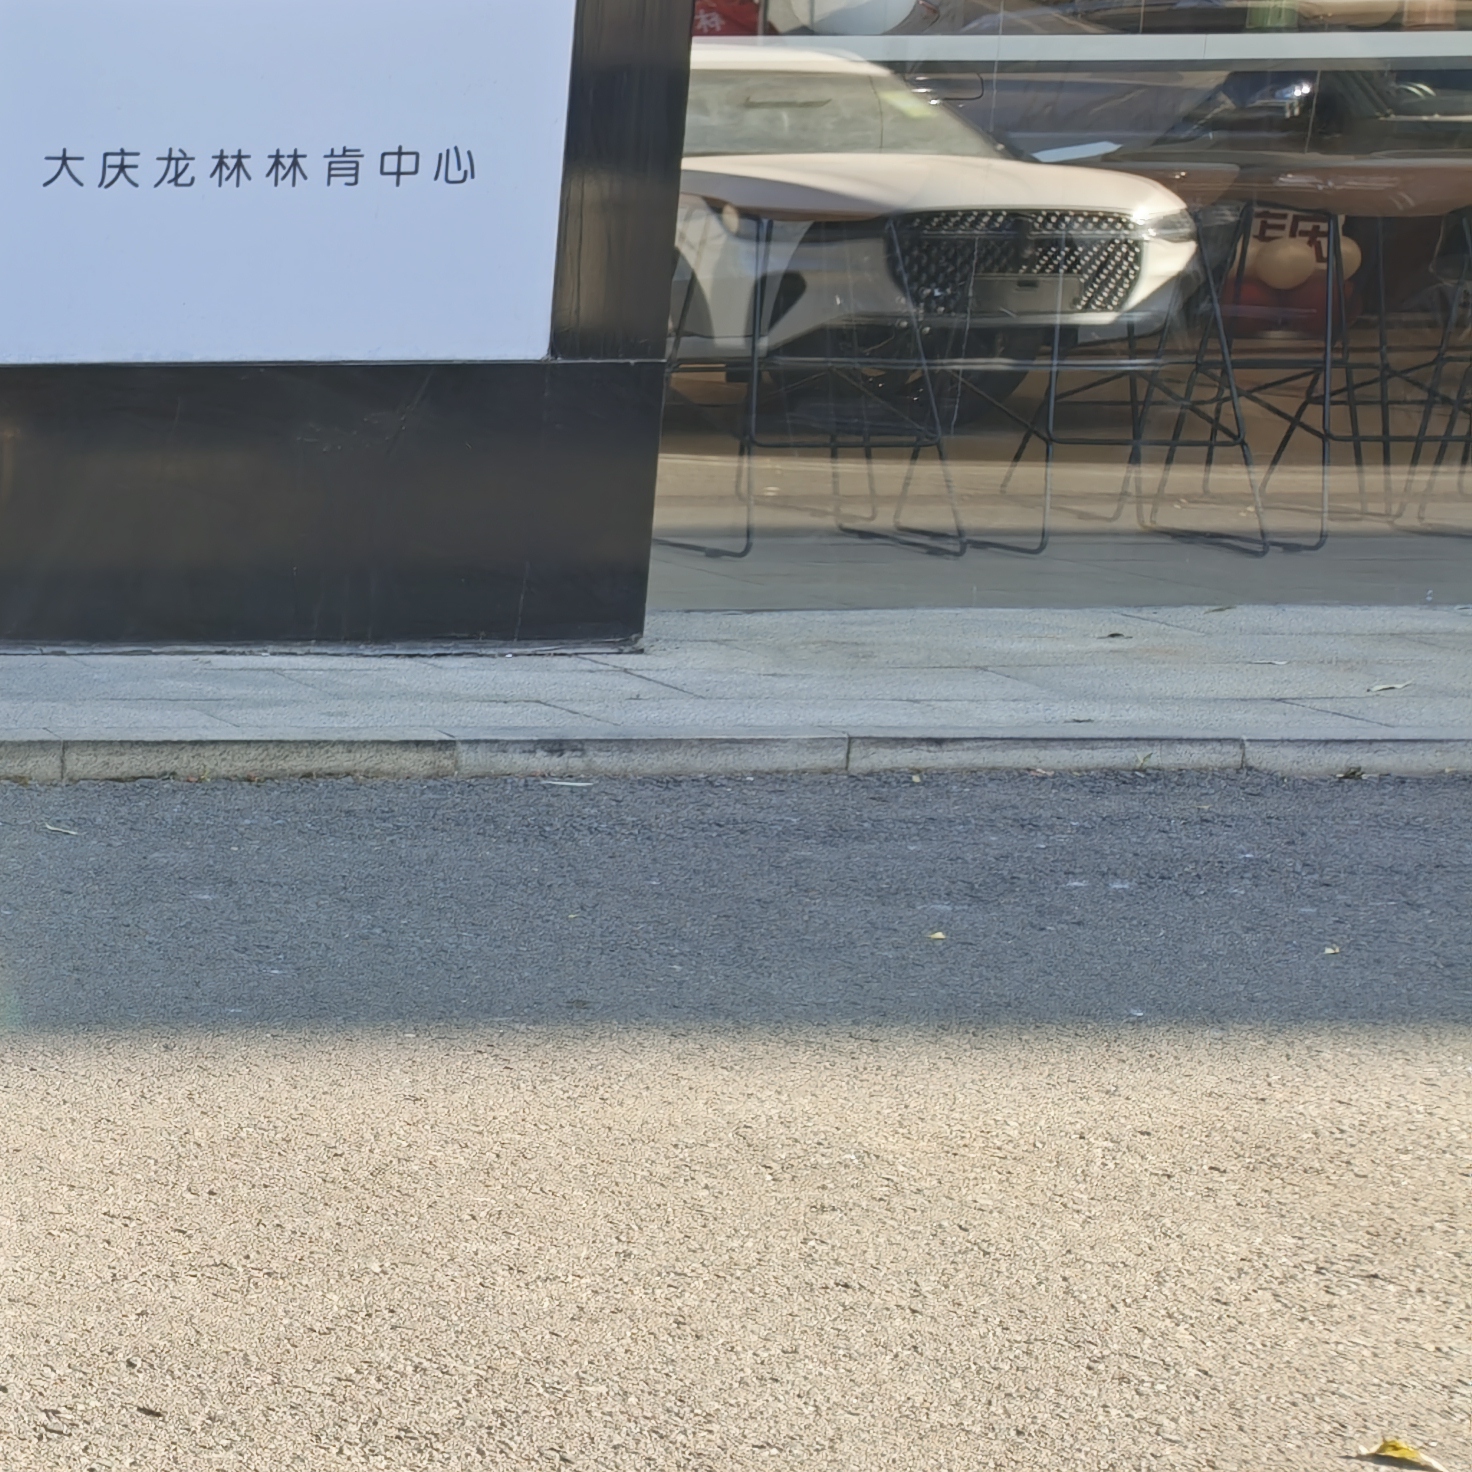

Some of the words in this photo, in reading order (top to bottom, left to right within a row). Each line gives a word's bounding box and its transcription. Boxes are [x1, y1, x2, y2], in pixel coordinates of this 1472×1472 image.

[41, 145, 477, 189] 大庆龙林林肯中心
